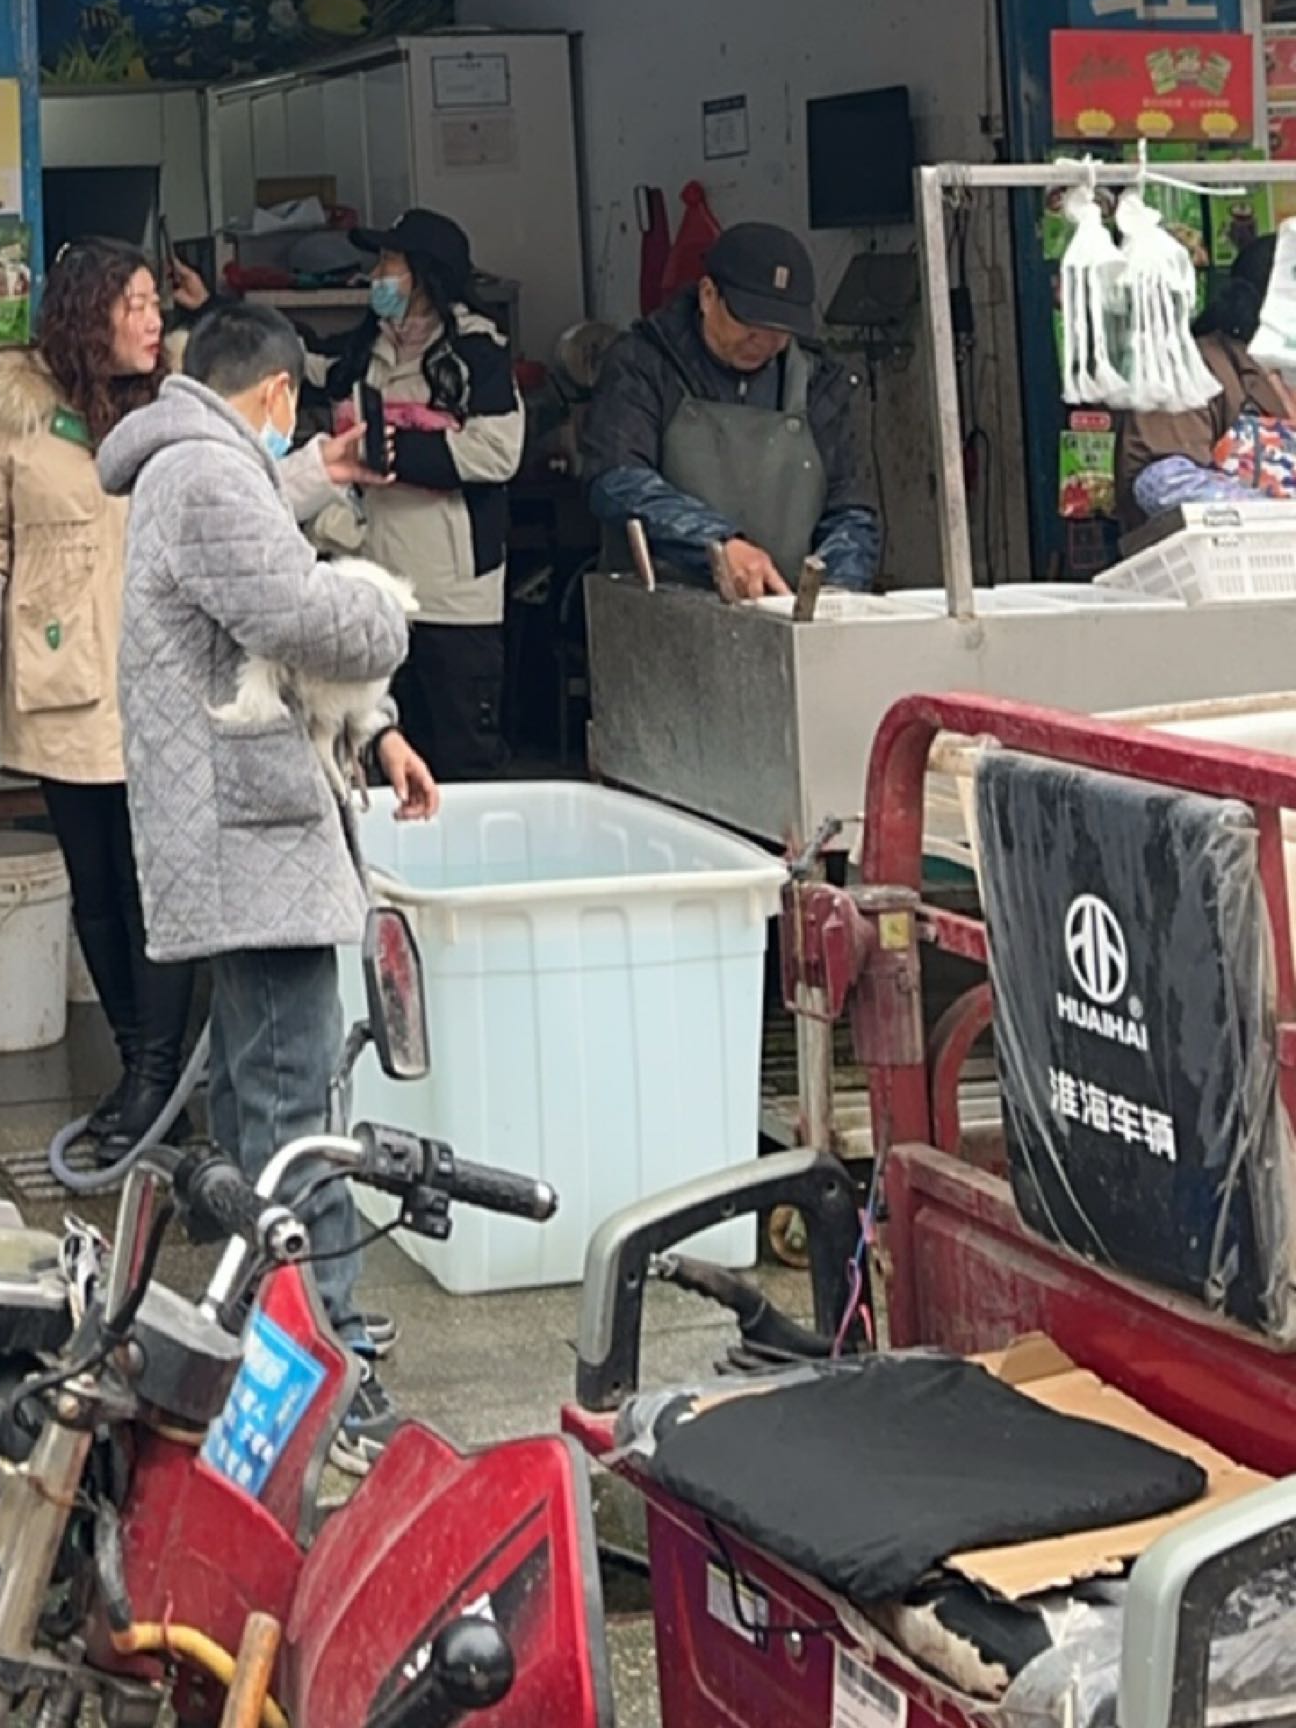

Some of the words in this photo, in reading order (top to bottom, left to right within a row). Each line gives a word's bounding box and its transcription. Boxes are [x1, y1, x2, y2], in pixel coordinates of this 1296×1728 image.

[1056, 992, 1148, 1051] HUAIHAI
[1049, 1065, 1176, 1162] 淮海车辆
